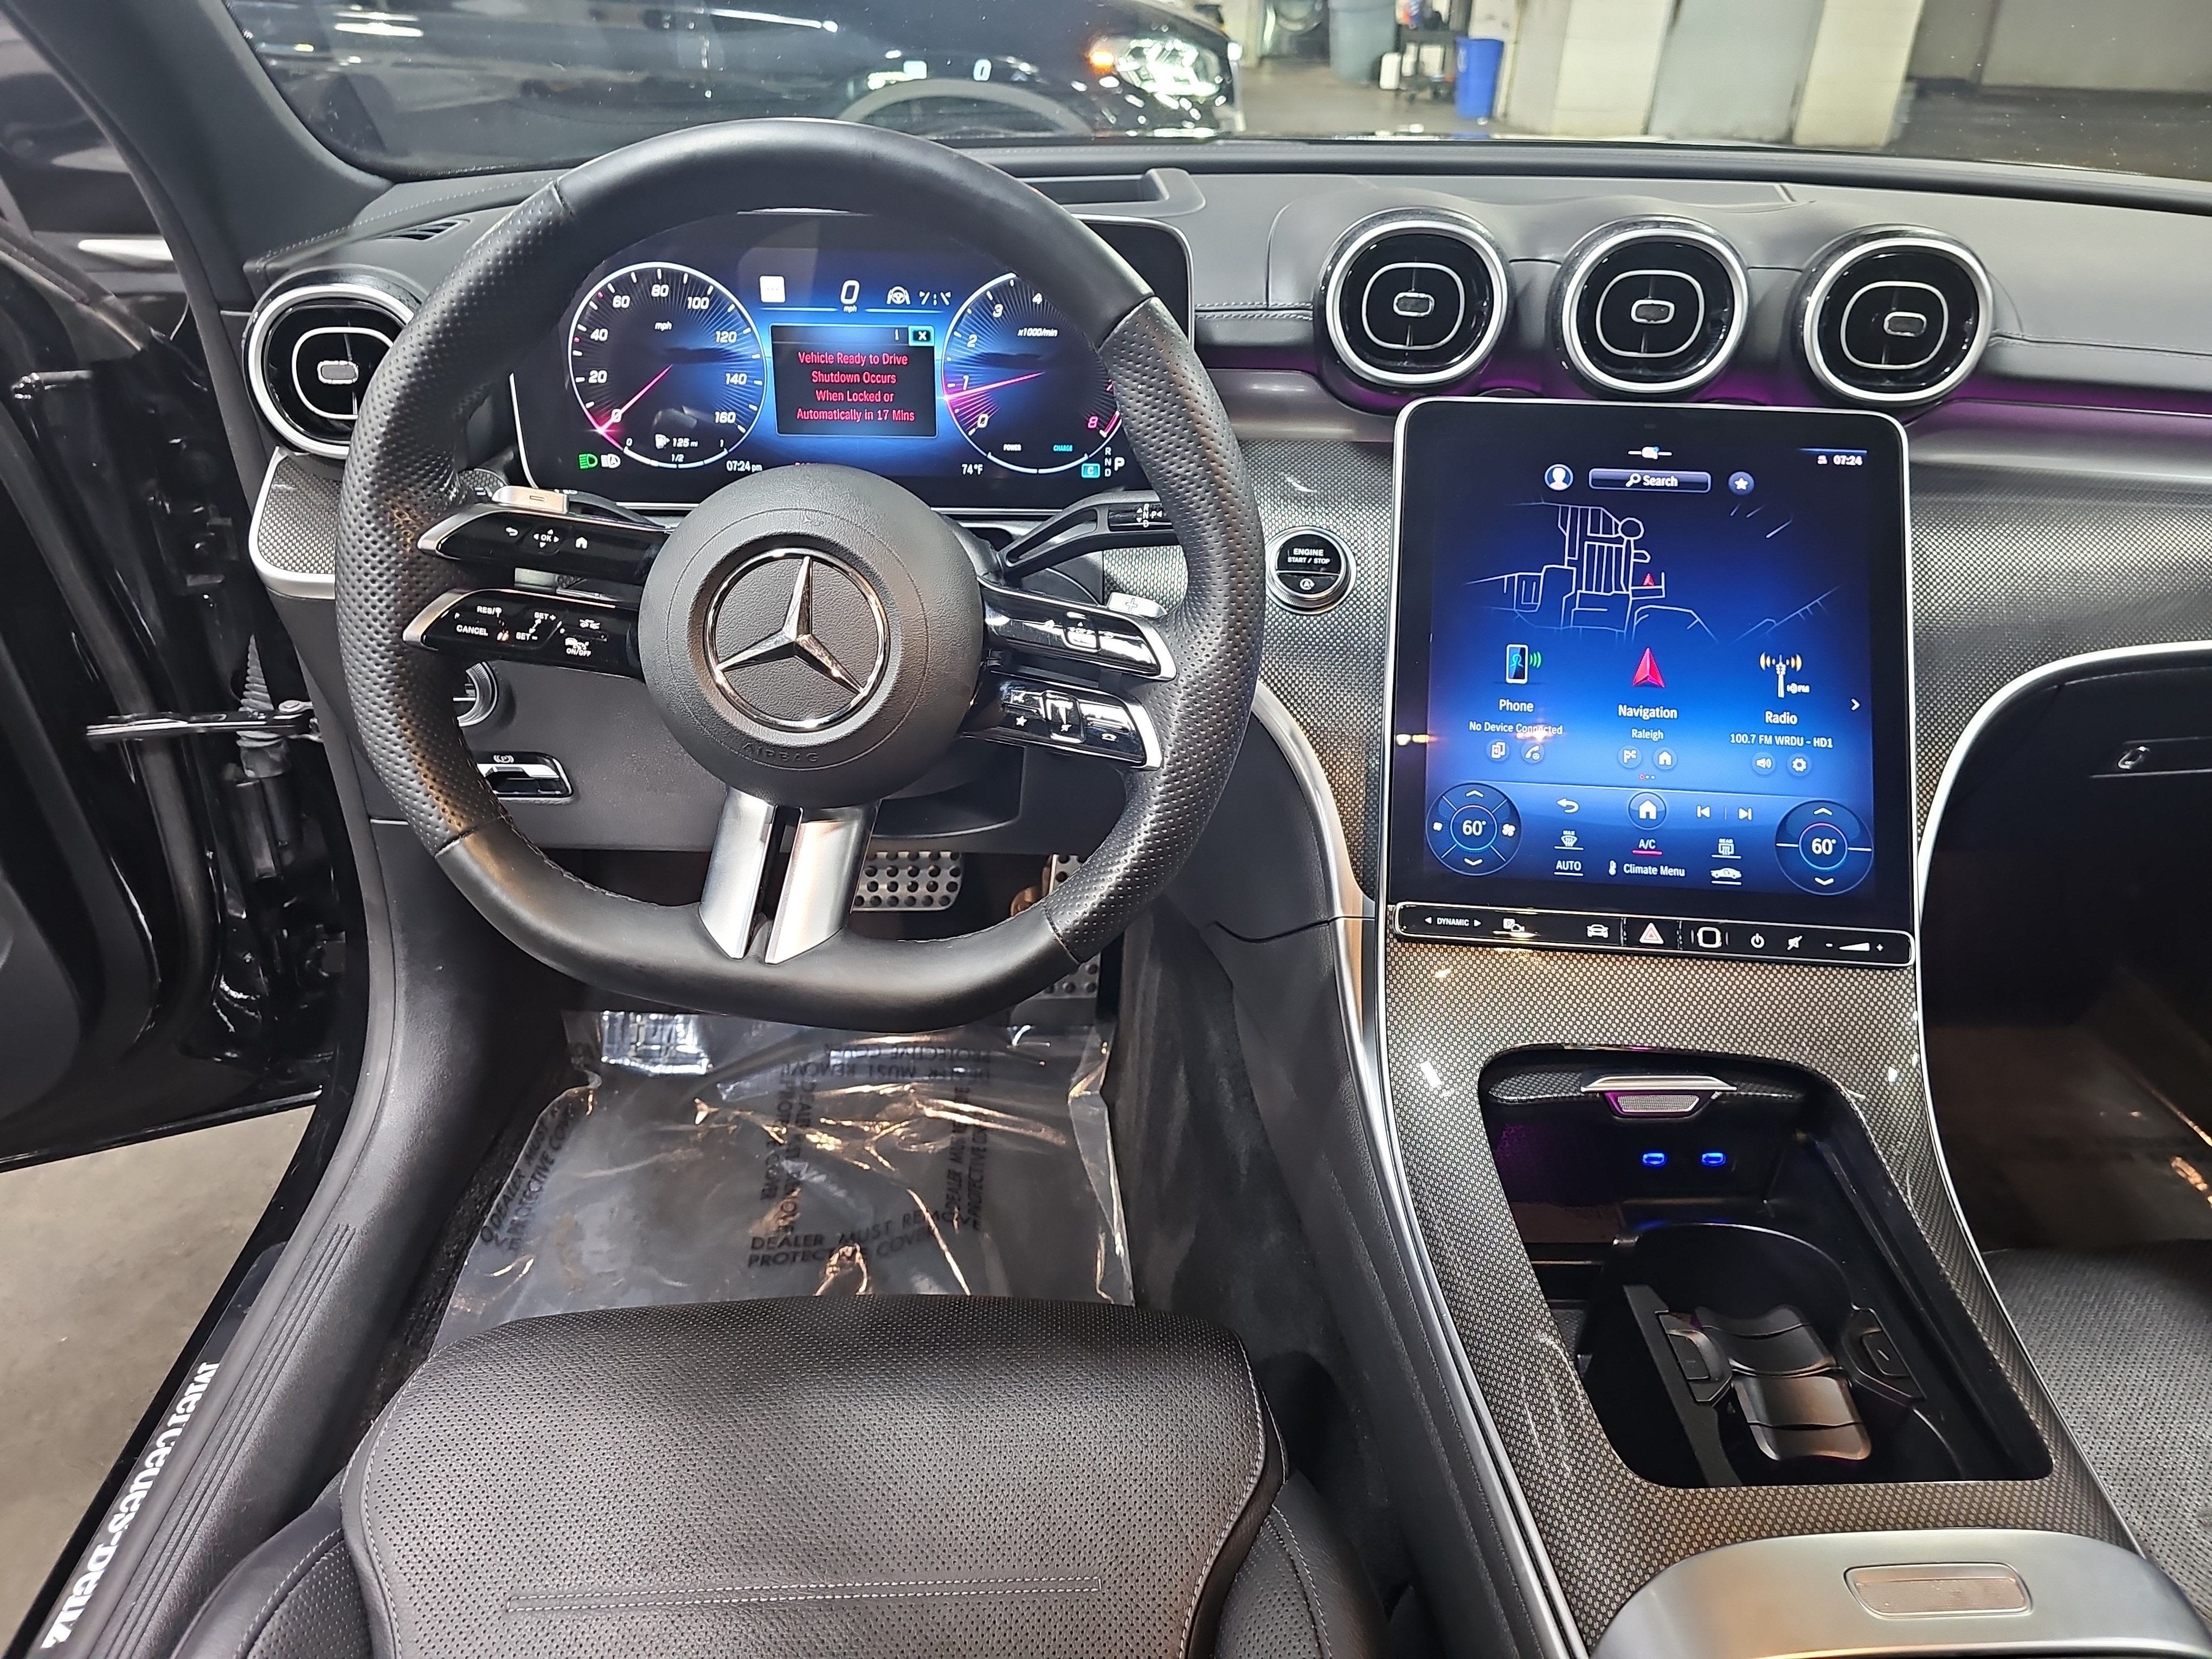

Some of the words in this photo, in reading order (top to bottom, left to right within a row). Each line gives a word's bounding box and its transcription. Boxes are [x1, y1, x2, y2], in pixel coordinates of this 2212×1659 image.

[651, 284, 669, 297] 80
[840, 280, 860, 304] 0
[613, 295, 630, 308] 60
[687, 297, 710, 309] 100
[1032, 293, 1042, 305] 4
[993, 304, 1003, 317] 3
[654, 321, 672, 331] mph
[590, 329, 608, 342] 40
[715, 331, 737, 343] 120
[967, 334, 978, 348] 2
[798, 351, 834, 364] Vehicle
[837, 352, 866, 366] Ready
[869, 355, 879, 364] to
[882, 353, 909, 365] Drive
[588, 370, 608, 383] 20
[725, 373, 747, 385] 140
[812, 371, 860, 384] Shutdown
[863, 372, 896, 384] Occurs
[963, 375, 969, 390] 1
[815, 390, 844, 402] When
[847, 390, 881, 403] Locked
[883, 393, 895, 402] or
[612, 409, 621, 423] 0
[715, 411, 736, 424] 160
[796, 408, 862, 422] Automatically
[865, 410, 873, 420] in
[877, 410, 890, 421] 17
[892, 410, 915, 421] Mins
[978, 414, 988, 428] 0
[1088, 416, 1098, 428] 8
[626, 438, 633, 446] 0
[672, 438, 690, 447] 125
[720, 439, 724, 447] 1
[1105, 447, 1111, 455] R
[671, 454, 684, 462] 1/2
[1105, 458, 1111, 466] N
[1114, 457, 1125, 471] P
[1832, 455, 1863, 466] 07:24
[726, 461, 750, 471] 07:24
[751, 464, 762, 473] pm
[1105, 468, 1111, 477] D
[1643, 475, 1679, 487] Search
[1143, 503, 1150, 511] R
[1143, 511, 1149, 519] N
[1151, 511, 1157, 519] P
[541, 534, 552, 542] OK
[1293, 548, 1324, 556] ENGINE
[456, 625, 488, 636] CANCEL
[566, 648, 591, 657] ON/OFF
[1499, 699, 1534, 712] Phone
[1618, 705, 1678, 720] Navigation
[1765, 711, 1798, 725] Radio
[1469, 721, 1482, 731] No
[1484, 722, 1514, 733] Device
[1515, 723, 1563, 735] Connected
[1631, 729, 1664, 741] Raleigh
[1730, 733, 1756, 744] 100.7
[1759, 735, 1772, 745] FM
[1774, 736, 1804, 747] WRDU
[1813, 737, 1833, 749] HD1
[742, 742, 819, 762] AIRBAG
[1638, 839, 1656, 850] A/C
[1556, 860, 1581, 871] AUTO
[1623, 863, 1658, 875] Climate
[1660, 865, 1685, 877] Menu
[1437, 917, 1470, 927] DYNAMIC
[491, 1167, 525, 1230] DEALER
[750, 1232, 825, 1251] DEALER
